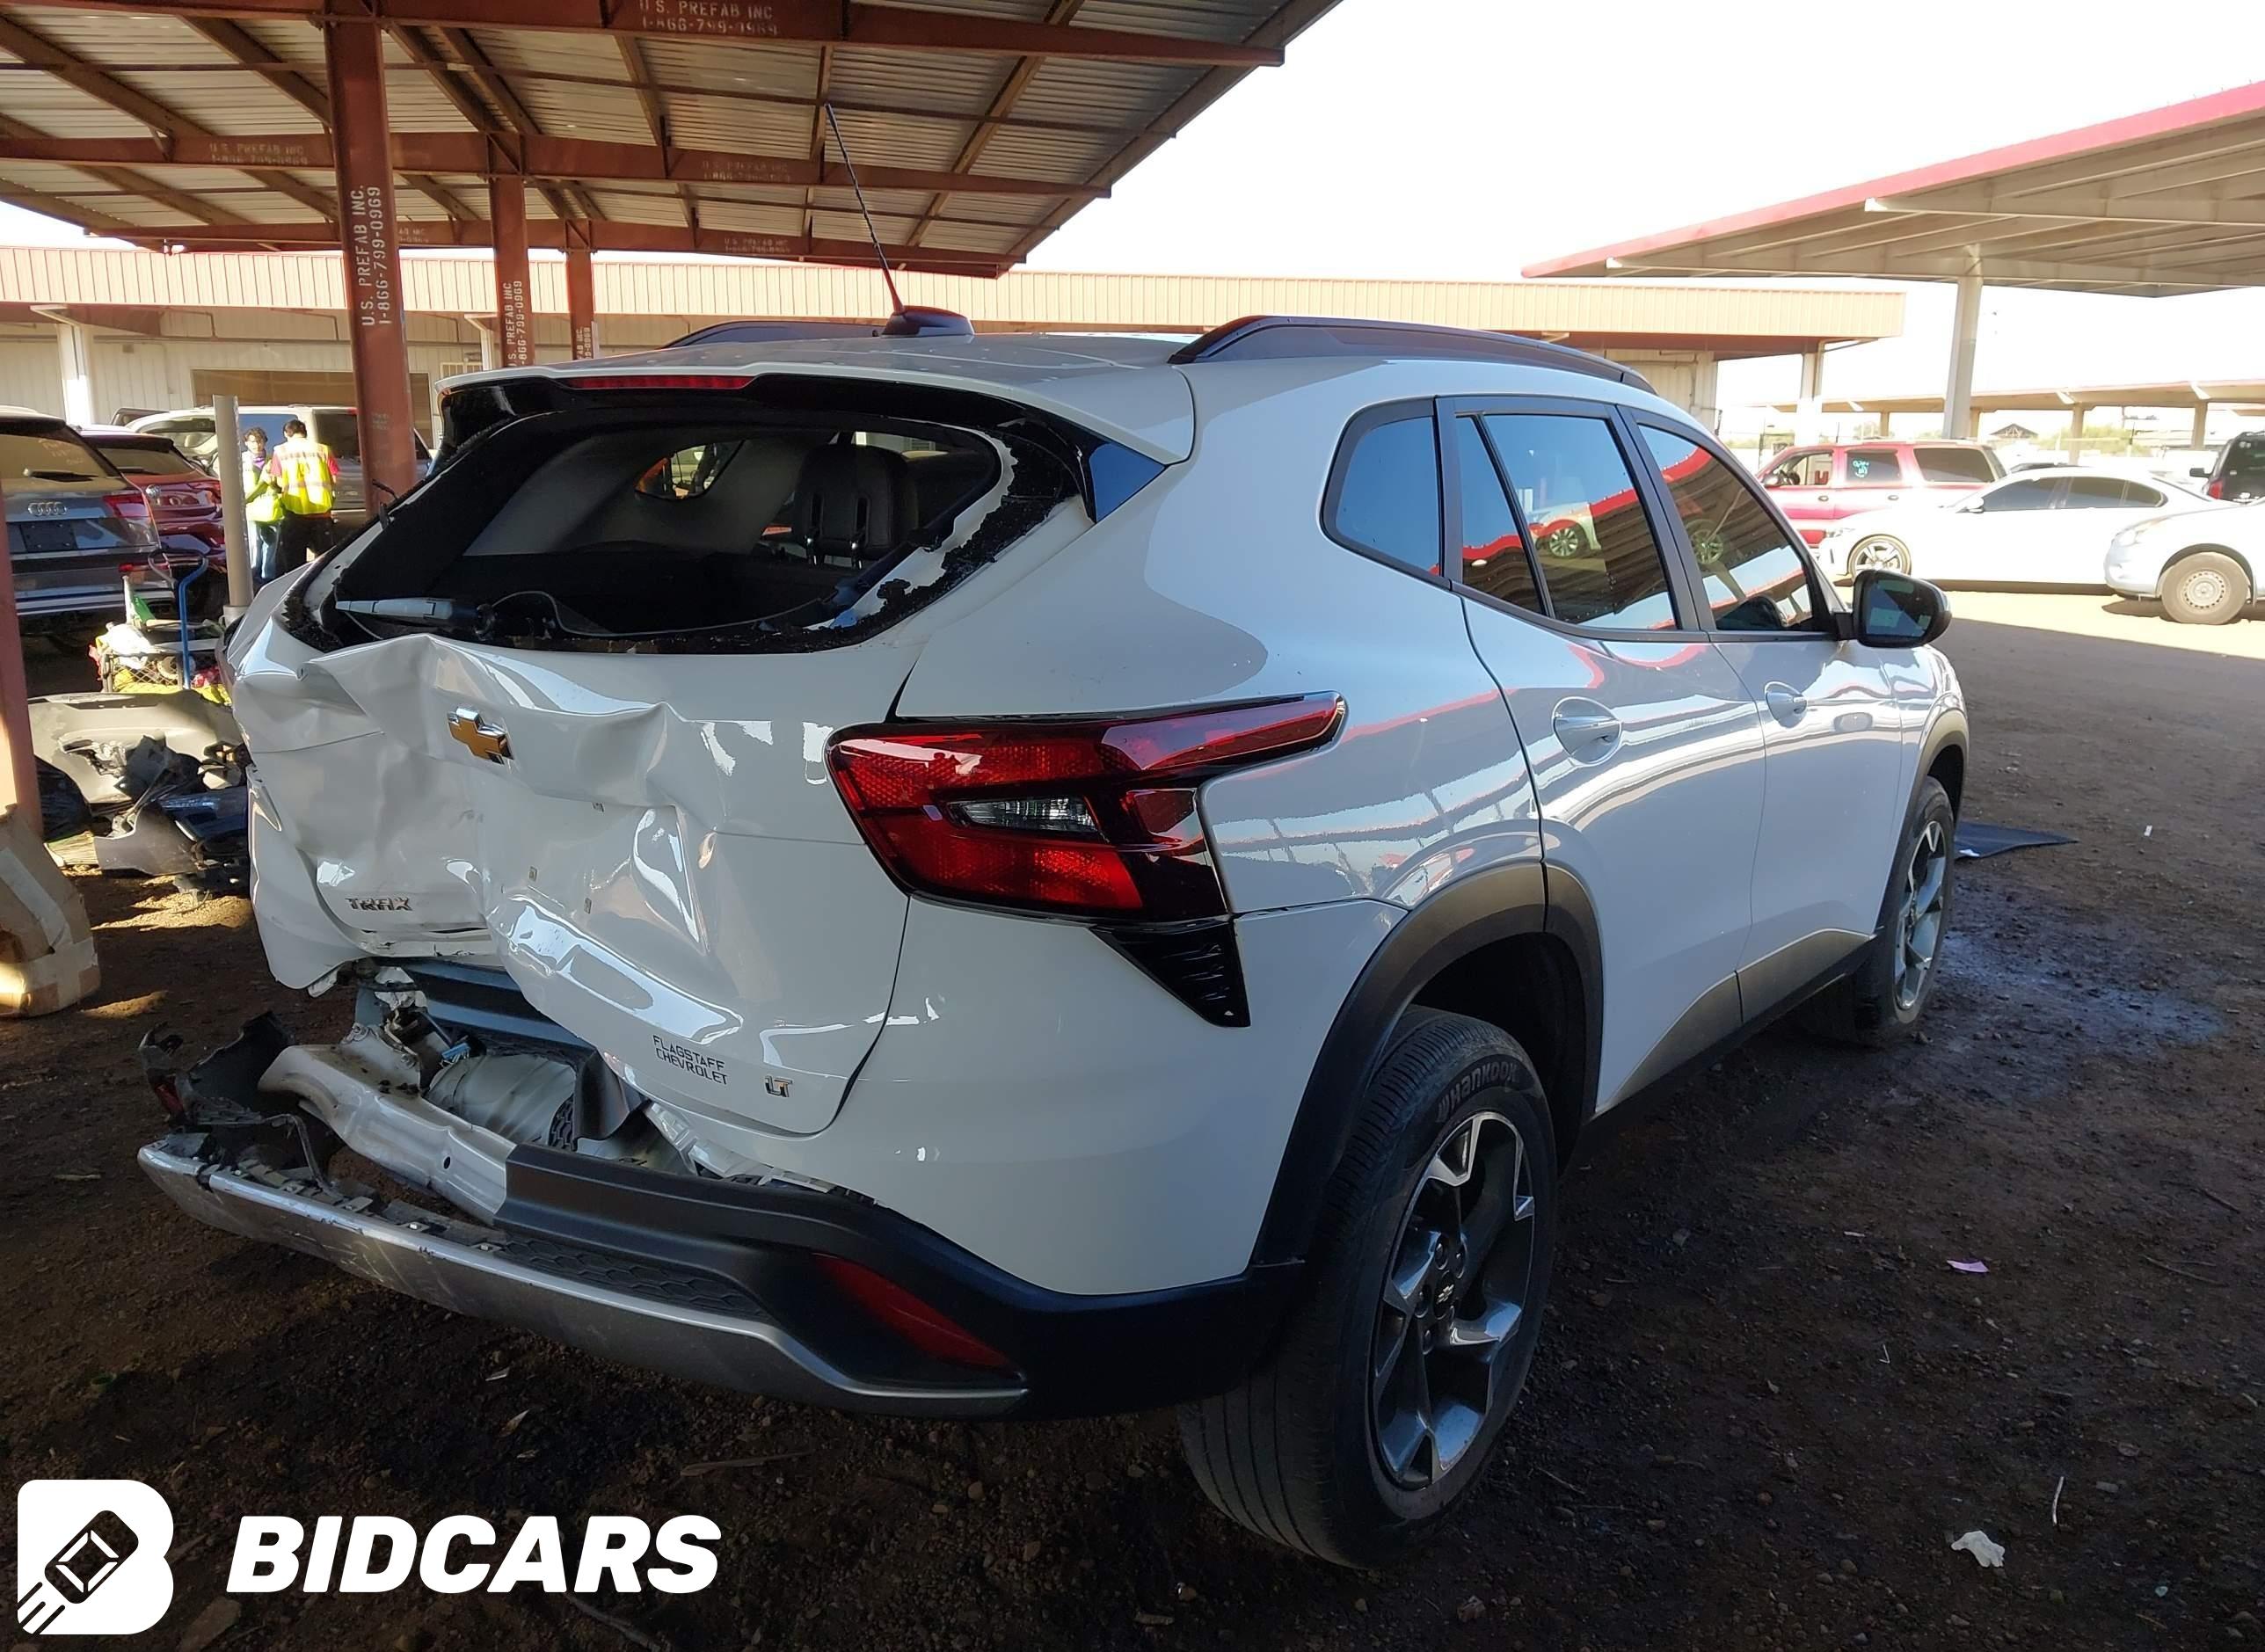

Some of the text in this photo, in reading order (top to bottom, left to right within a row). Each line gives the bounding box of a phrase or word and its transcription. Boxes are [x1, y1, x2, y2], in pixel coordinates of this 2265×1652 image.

[679, 1, 739, 18] PREFAB
[350, 185, 375, 326] U.S. PREFAB INC.
[367, 186, 392, 324] 1-866-799-0969
[504, 304, 516, 346] PREFAB
[513, 280, 528, 365] -866-799-0969
[652, 1035, 725, 1072] FLAGSTAFF
[655, 1047, 728, 1086] CHEVROLET
[764, 1075, 793, 1098] LT
